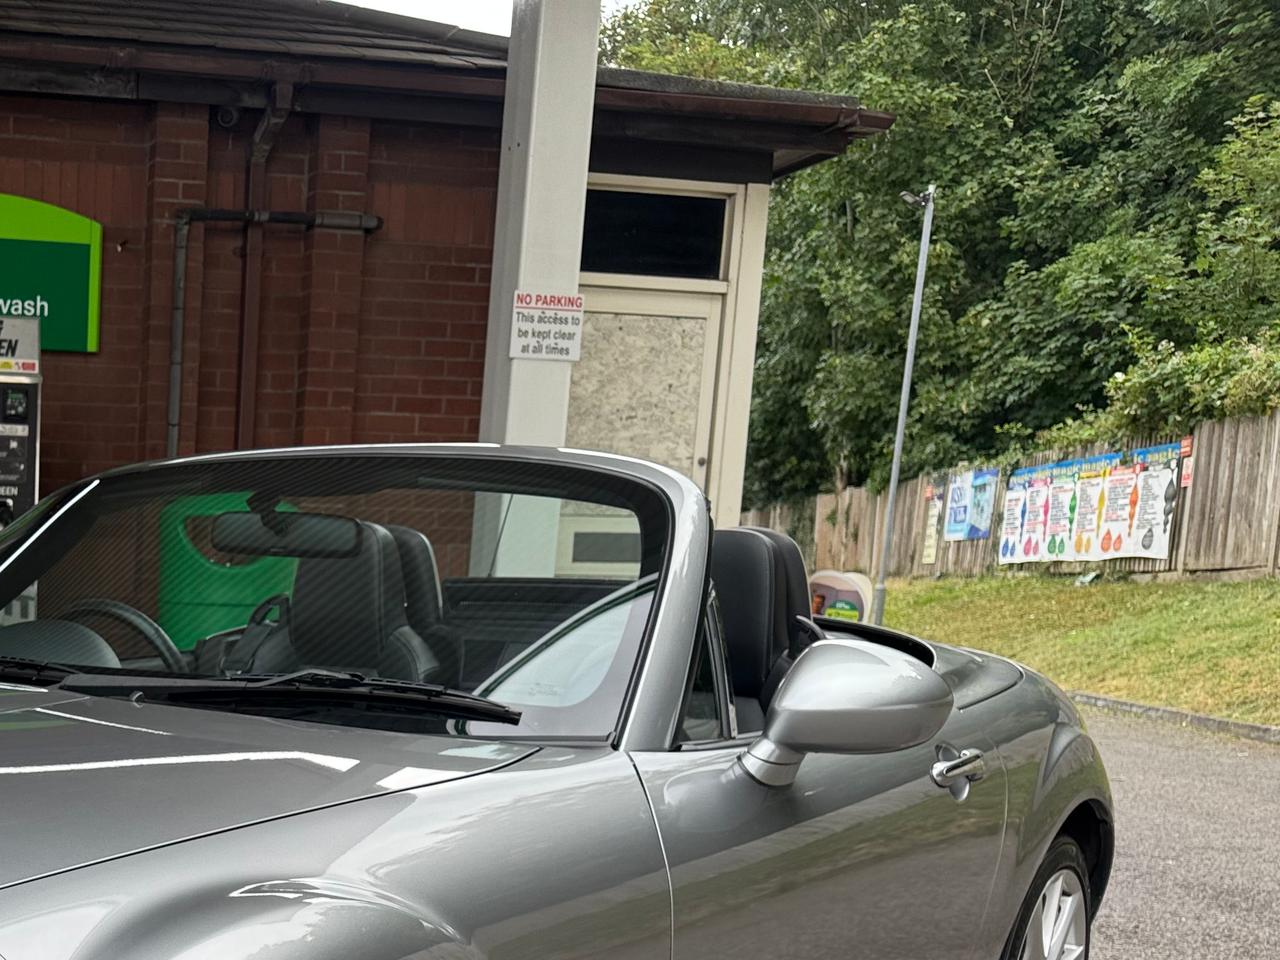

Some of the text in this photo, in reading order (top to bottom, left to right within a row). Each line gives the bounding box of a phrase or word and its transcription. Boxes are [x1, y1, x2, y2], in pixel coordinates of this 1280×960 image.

[516, 293, 583, 309] NO PARKING
[516, 311, 580, 326] This access to
[517, 327, 576, 341] be kept clear
[520, 343, 570, 356] at all times
